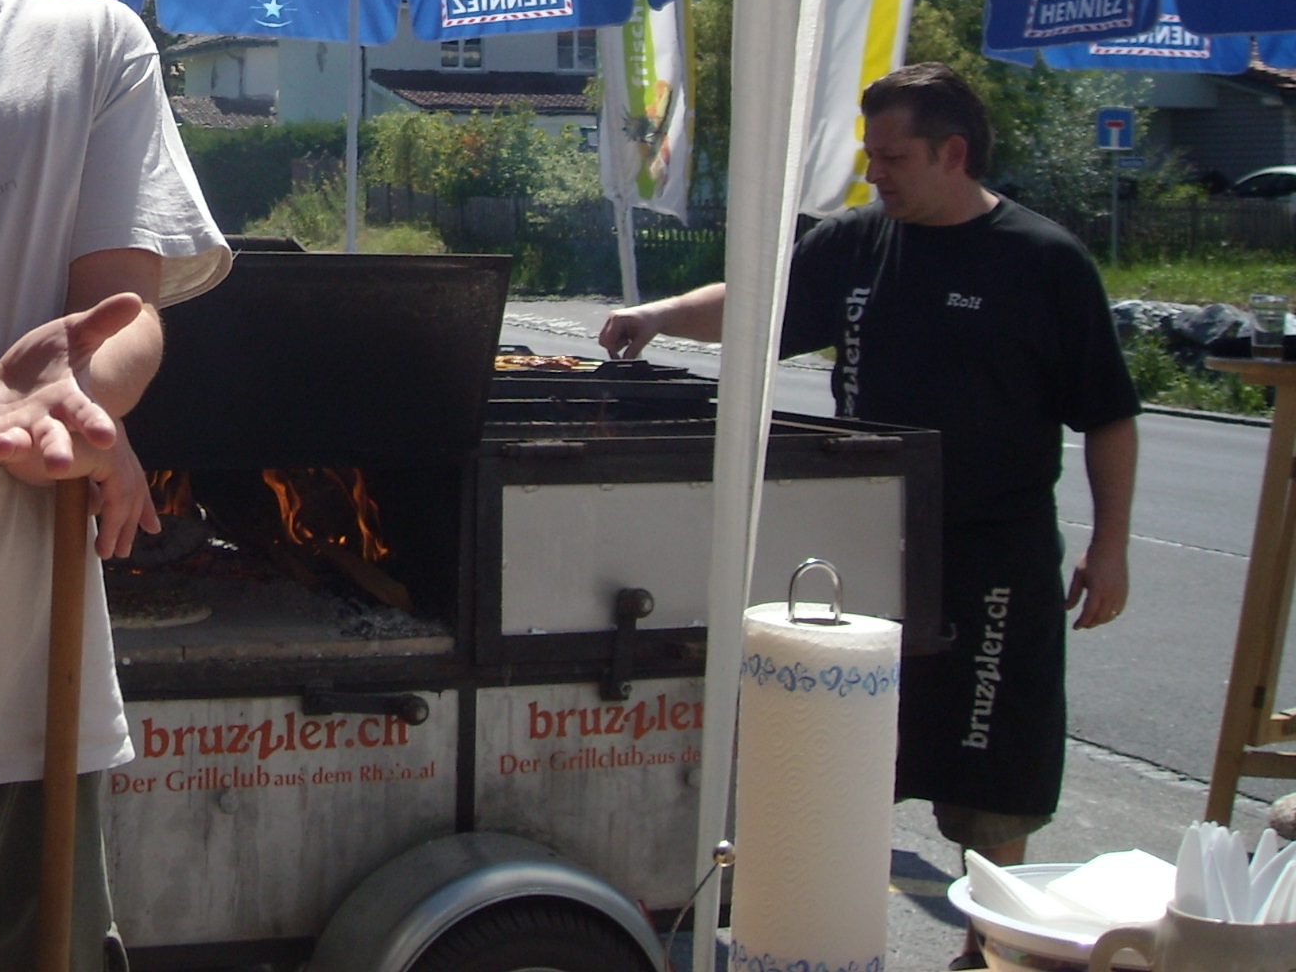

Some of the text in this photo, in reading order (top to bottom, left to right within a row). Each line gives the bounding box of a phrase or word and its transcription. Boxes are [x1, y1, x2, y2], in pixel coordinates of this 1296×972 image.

[946, 292, 983, 310] Rolf
[499, 745, 702, 775] Der Grillclub aus de
[110, 772, 156, 795] Der
[165, 765, 270, 793] Grillclub
[274, 773, 305, 787] aus
[312, 766, 352, 786] dem
